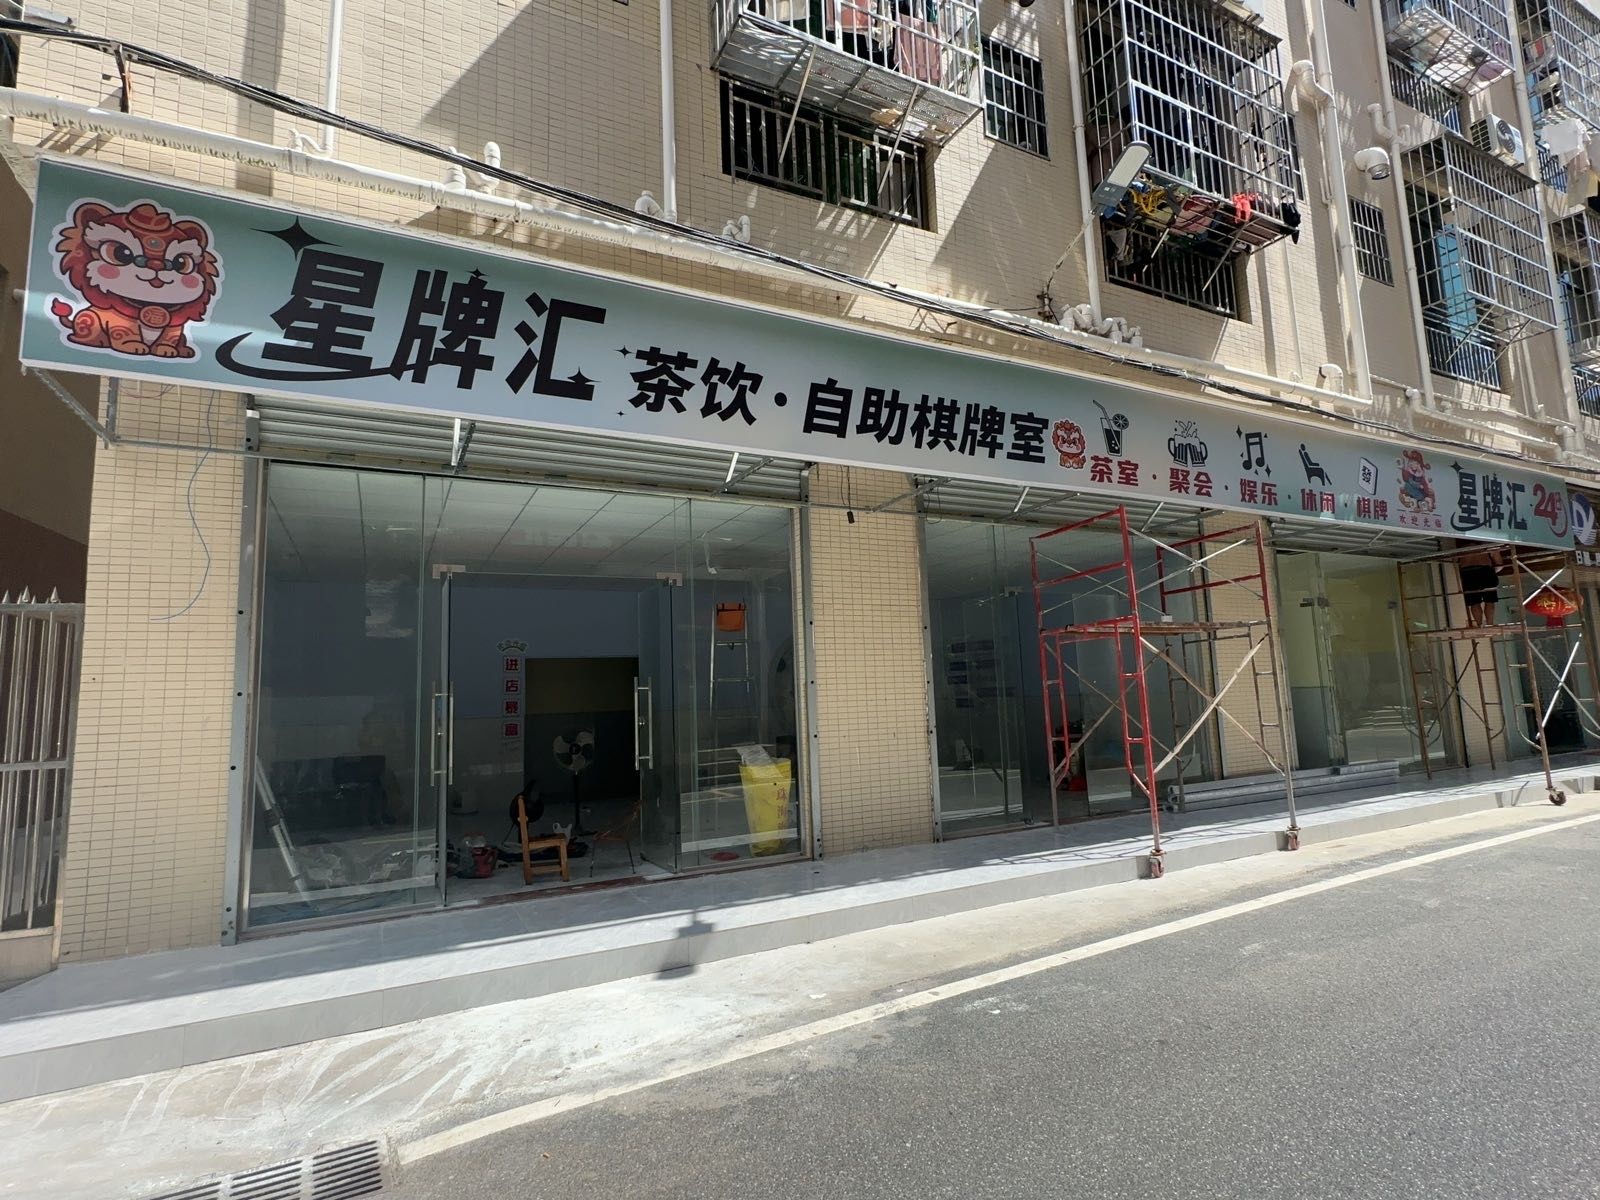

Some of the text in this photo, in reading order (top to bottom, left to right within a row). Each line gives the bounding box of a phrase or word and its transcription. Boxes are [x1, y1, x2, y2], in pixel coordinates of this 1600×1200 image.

[261, 249, 607, 402] 星牌汇
[1457, 471, 1528, 531] 星牌汇
